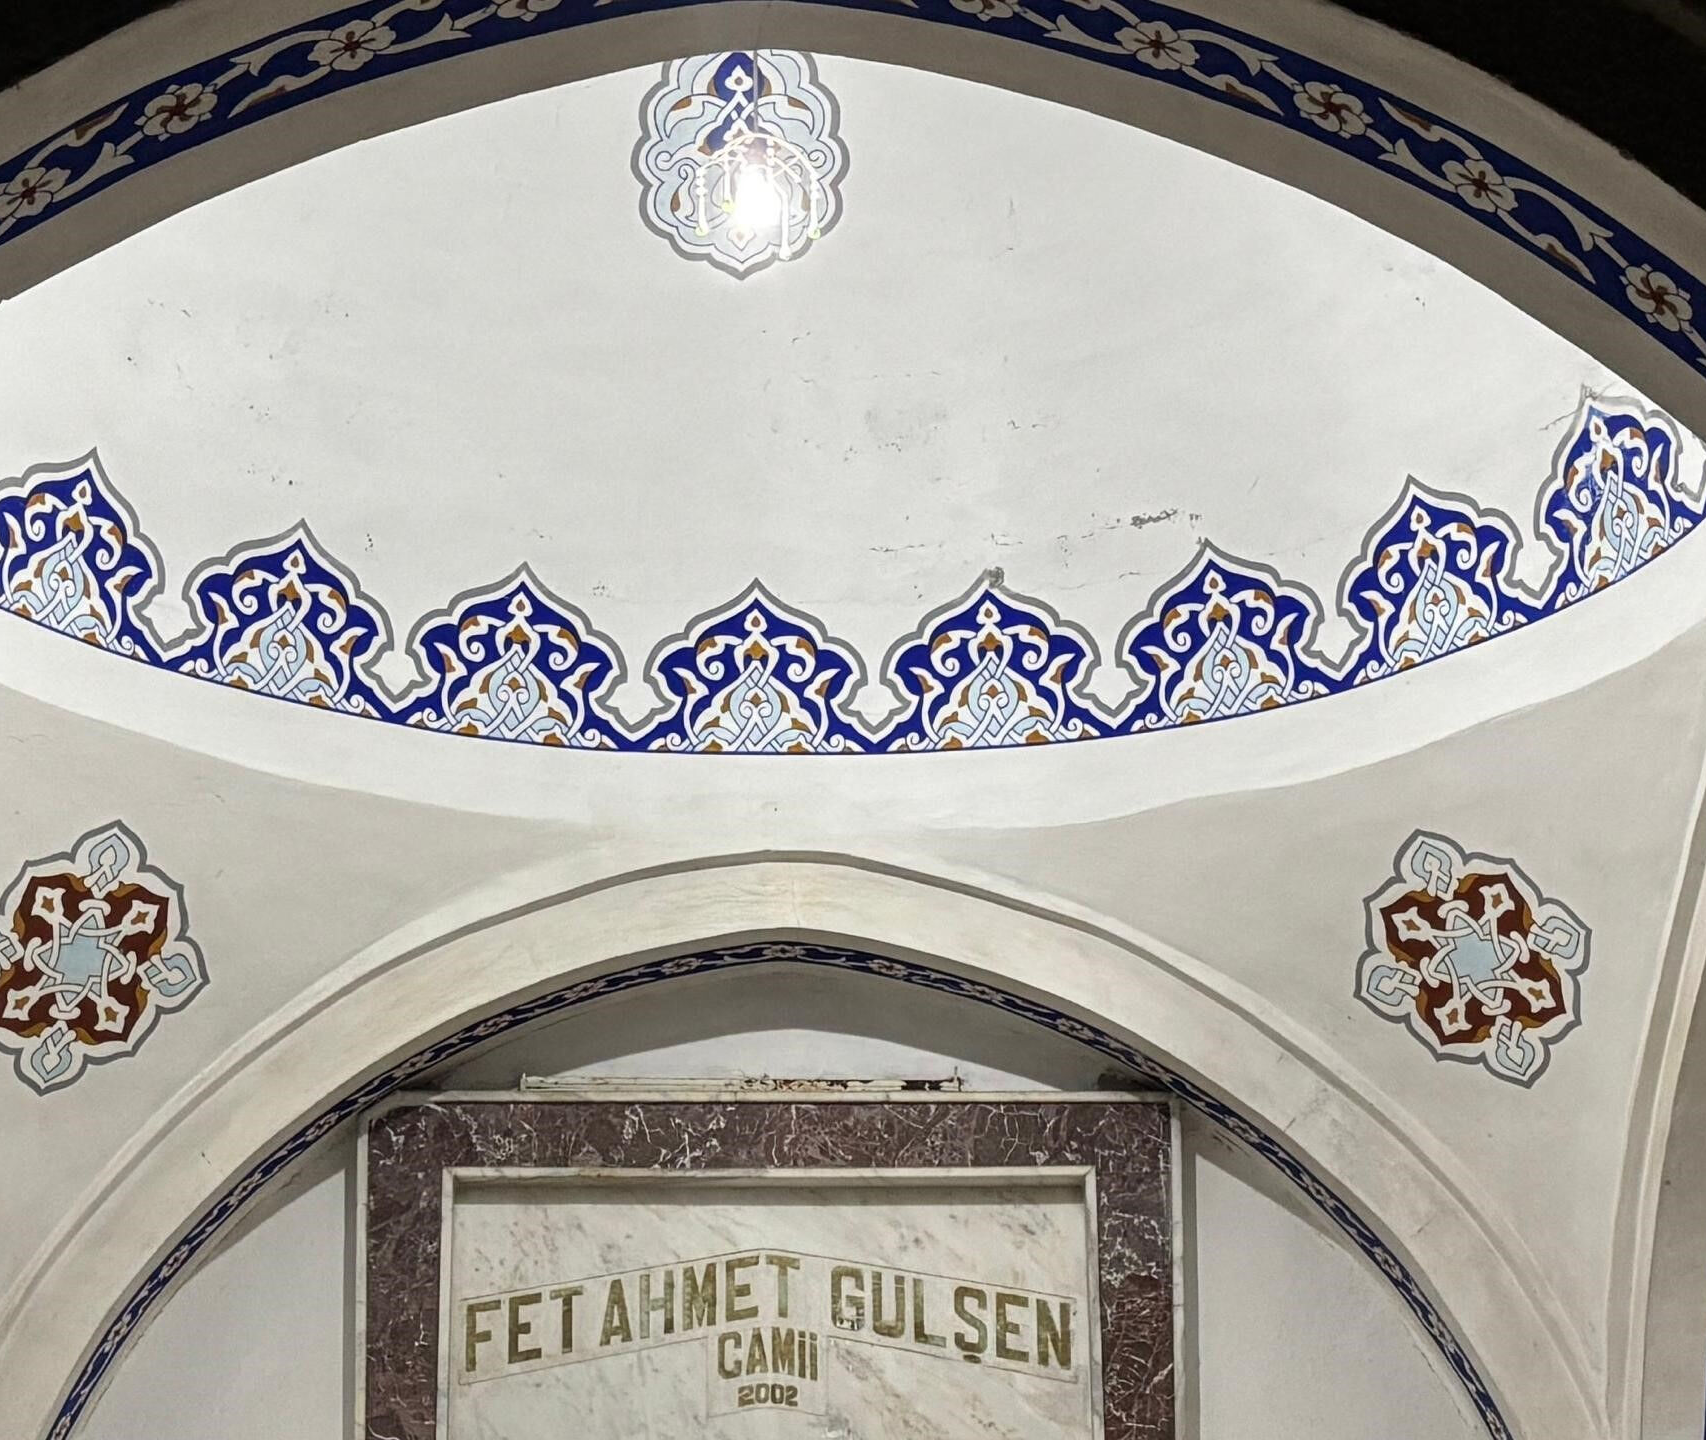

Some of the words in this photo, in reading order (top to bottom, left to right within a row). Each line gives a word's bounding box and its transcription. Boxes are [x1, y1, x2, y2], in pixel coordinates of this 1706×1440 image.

[465, 1287, 584, 1373] FET
[600, 1254, 801, 1347] AHMET
[737, 1382, 799, 1408] 2002
